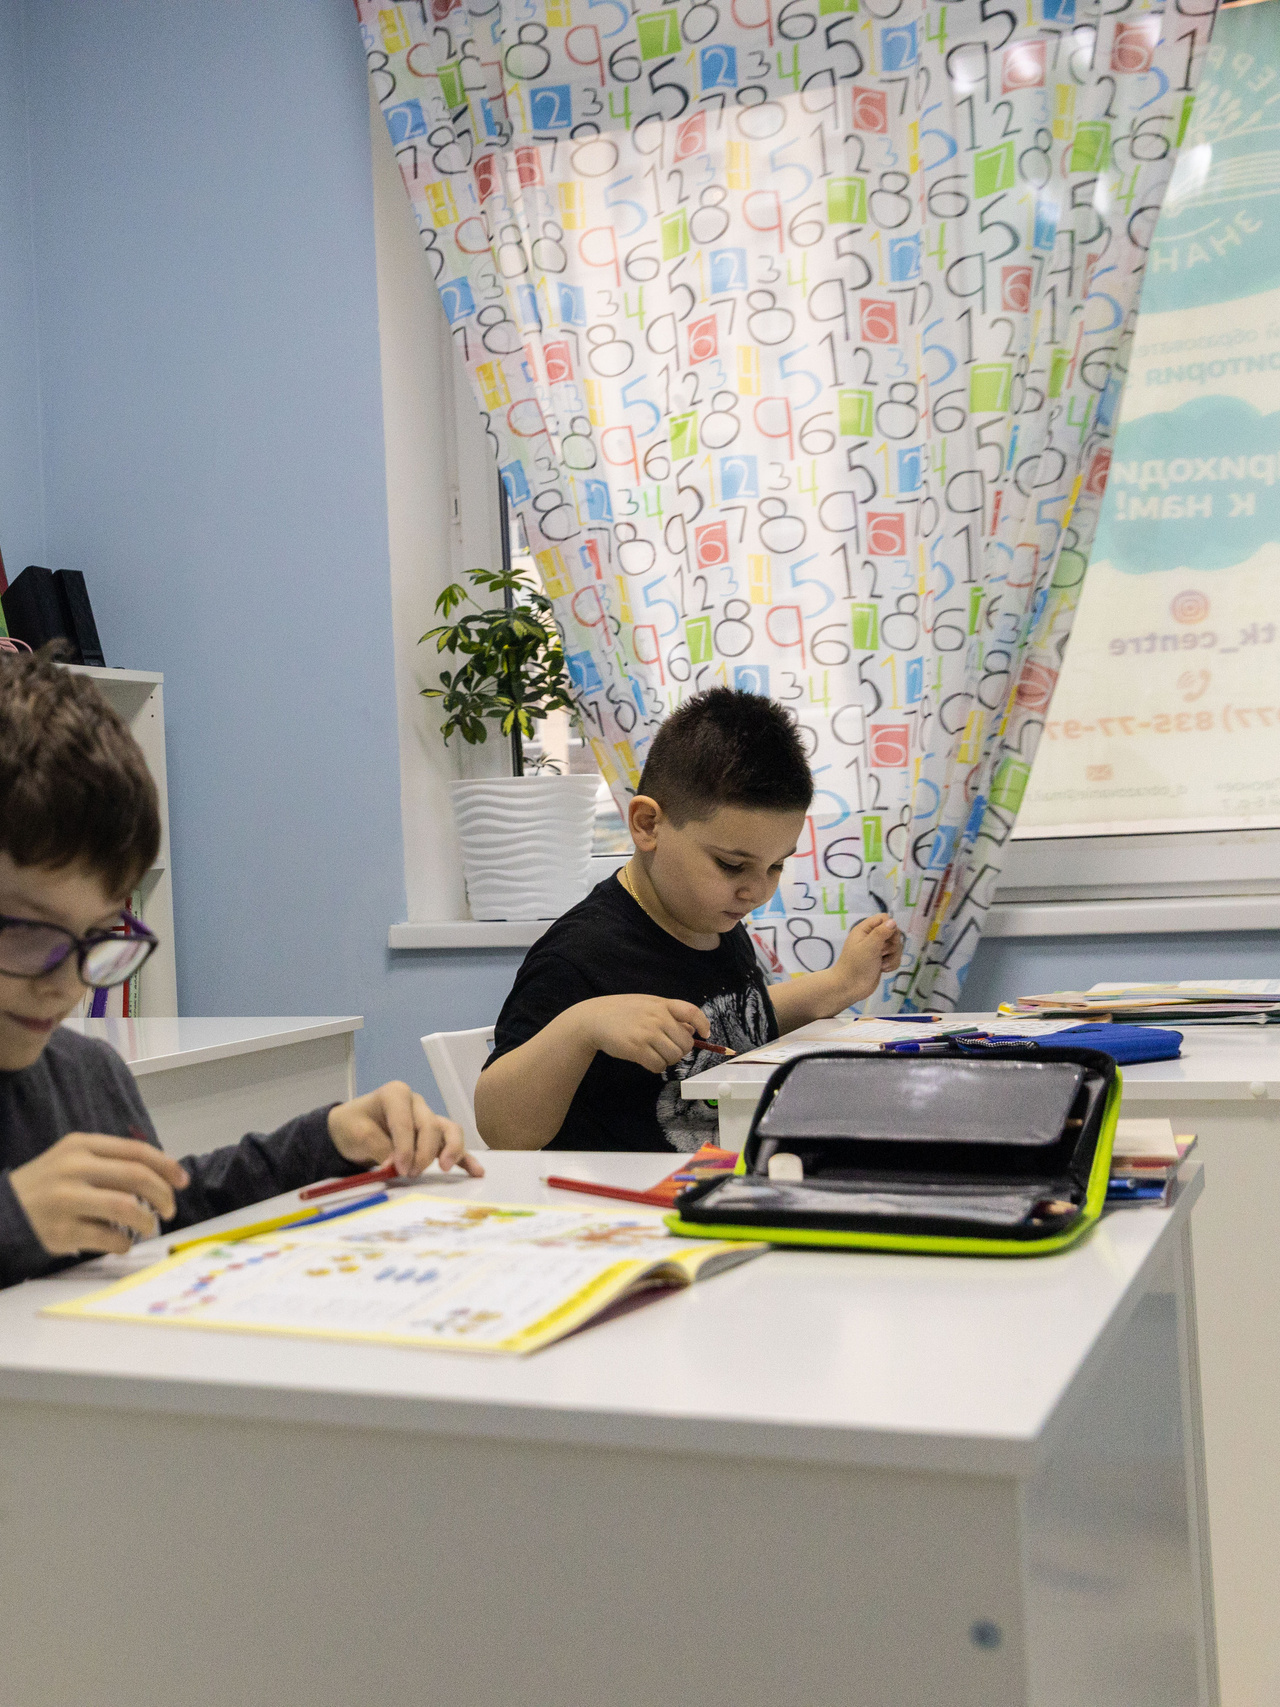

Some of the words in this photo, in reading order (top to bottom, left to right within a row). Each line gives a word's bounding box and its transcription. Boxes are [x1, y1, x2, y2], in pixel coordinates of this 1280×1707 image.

[639, 14, 670, 52] 7
[778, 0, 817, 40] 6
[825, 16, 864, 79] 5
[505, 22, 551, 80] 8
[565, 24, 605, 87] 9
[609, 40, 642, 82] 6
[704, 50, 735, 87] 2
[887, 32, 917, 68] 2
[945, 41, 991, 102] 9
[1174, 28, 1197, 92] 1
[534, 91, 568, 128] 2
[649, 57, 690, 121] 5
[736, 85, 787, 139] 8
[800, 68, 839, 129] 9
[880, 77, 909, 115] 7
[632, 112, 665, 169] 9
[676, 112, 705, 158] 6
[921, 102, 958, 171] 5
[993, 101, 1021, 138] 2
[533, 136, 558, 172] 7
[571, 122, 618, 177] 8
[770, 138, 813, 203] 5
[810, 122, 832, 178] 1
[877, 137, 898, 167] 3
[978, 147, 1007, 189] 7
[1019, 128, 1053, 190] 8
[604, 175, 648, 238] 5
[688, 184, 730, 244] 8
[742, 190, 784, 253] 9
[869, 171, 912, 229] 8
[928, 174, 970, 219] 6
[532, 220, 568, 273] 8
[789, 202, 825, 247] 6
[979, 192, 1019, 262] 5
[579, 226, 621, 287] 9
[625, 240, 661, 281] 6
[714, 252, 746, 289] 2
[834, 228, 871, 290] 5
[893, 240, 920, 277] 2
[946, 253, 987, 314] 9
[440, 287, 470, 319] 2
[481, 274, 504, 299] 3
[537, 276, 559, 328] 1
[668, 257, 696, 322] 5
[808, 277, 850, 341] 9
[887, 286, 918, 325] 7
[646, 311, 680, 371] 9
[690, 320, 717, 361] 6
[747, 290, 795, 345] 8
[862, 303, 894, 343] 6
[990, 317, 1017, 357] 2
[1043, 285, 1060, 345] 1
[586, 324, 634, 378] 8
[778, 343, 823, 410] 5
[818, 331, 845, 387] 1
[923, 318, 957, 386] 5
[621, 374, 661, 438] 5
[875, 382, 918, 440] 8
[932, 388, 966, 433] 6
[973, 367, 1008, 408] 7
[507, 398, 556, 455] 9
[561, 416, 597, 470] 8
[700, 391, 740, 449] 8
[754, 396, 794, 460] 9
[799, 411, 836, 455] 6
[1068, 395, 1095, 444] 4
[601, 426, 640, 486] 9
[643, 440, 670, 481] 6
[846, 441, 877, 504] 5
[977, 416, 1005, 483] 5
[676, 460, 704, 523] 5
[724, 459, 756, 496] 2
[945, 470, 985, 536] 9
[588, 527, 611, 563] 7
[613, 522, 655, 575] 8
[664, 513, 691, 573] 9
[720, 506, 747, 543] 7
[758, 496, 806, 554] 8
[819, 491, 859, 554] 9
[869, 516, 902, 555] 6
[891, 560, 915, 589] 3
[953, 524, 977, 583] 1
[642, 575, 679, 637] 5
[720, 567, 739, 596] 3
[789, 552, 836, 619] 5
[571, 585, 611, 646] 9
[714, 599, 754, 657] 8
[766, 604, 806, 670] 9
[881, 593, 919, 651] 8
[932, 608, 966, 651] 6
[632, 624, 665, 686] 9
[668, 641, 692, 682] 6
[810, 623, 850, 665] 6
[779, 672, 804, 699] 3
[881, 654, 903, 709] 1
[832, 705, 868, 767] 9
[872, 728, 907, 766] 6
[824, 837, 863, 879] 6
[793, 882, 816, 911] 3
[822, 883, 848, 930] 4
[787, 917, 834, 973] 8
